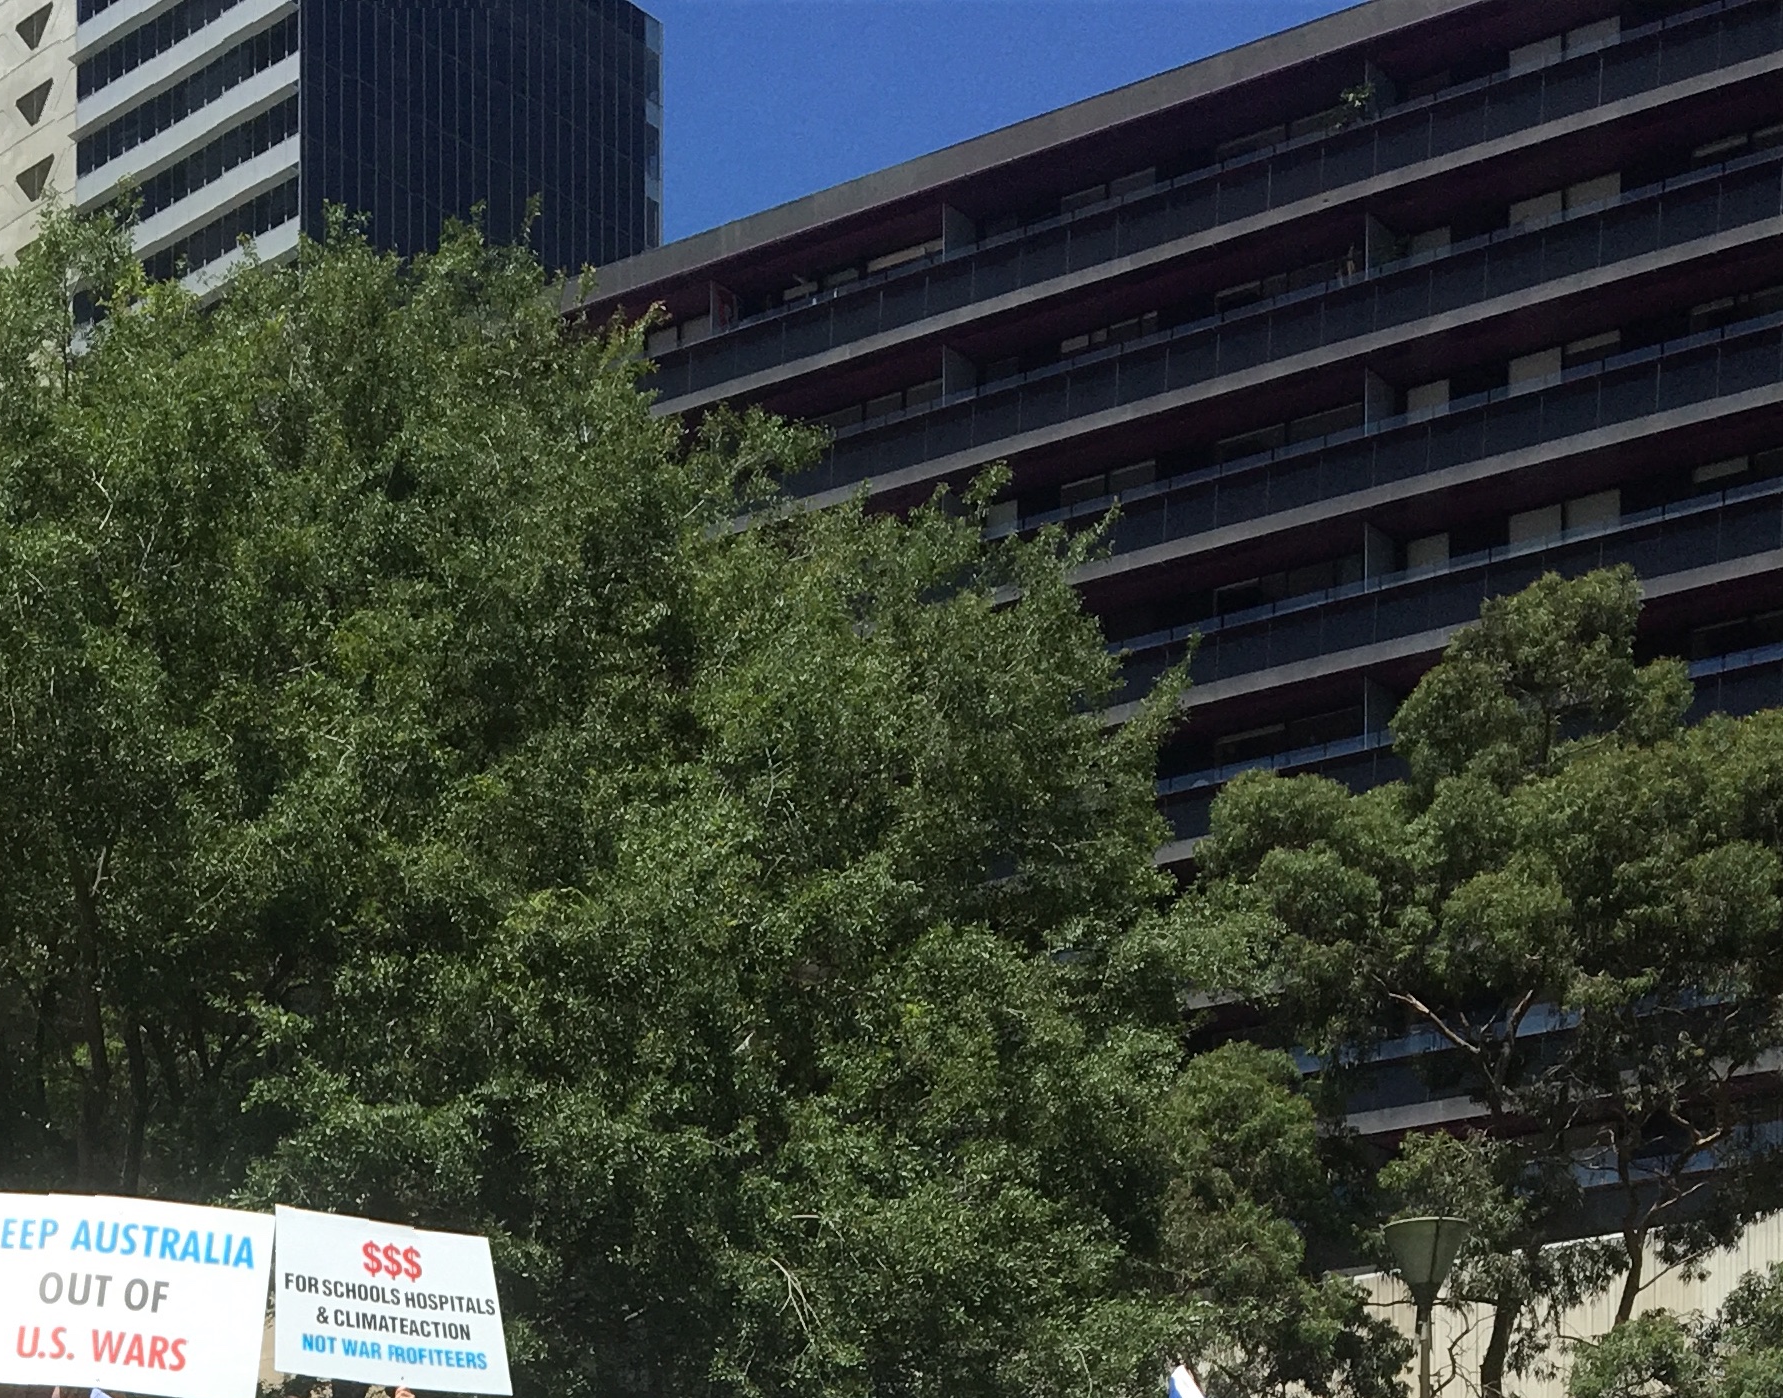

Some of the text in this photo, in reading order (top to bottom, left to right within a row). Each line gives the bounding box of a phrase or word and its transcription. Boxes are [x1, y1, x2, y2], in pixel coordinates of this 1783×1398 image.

[72, 1219, 256, 1269] AUSTRALIA
[362, 1240, 423, 1282] $$$
[38, 1271, 169, 1314] OUT OF
[284, 1272, 496, 1316] FOR SCHOOLS HOSPITALS
[316, 1306, 332, 1327] &
[16, 1325, 188, 1372] U.S. WARS
[302, 1332, 488, 1371] NOT WAR PROFITEERS
